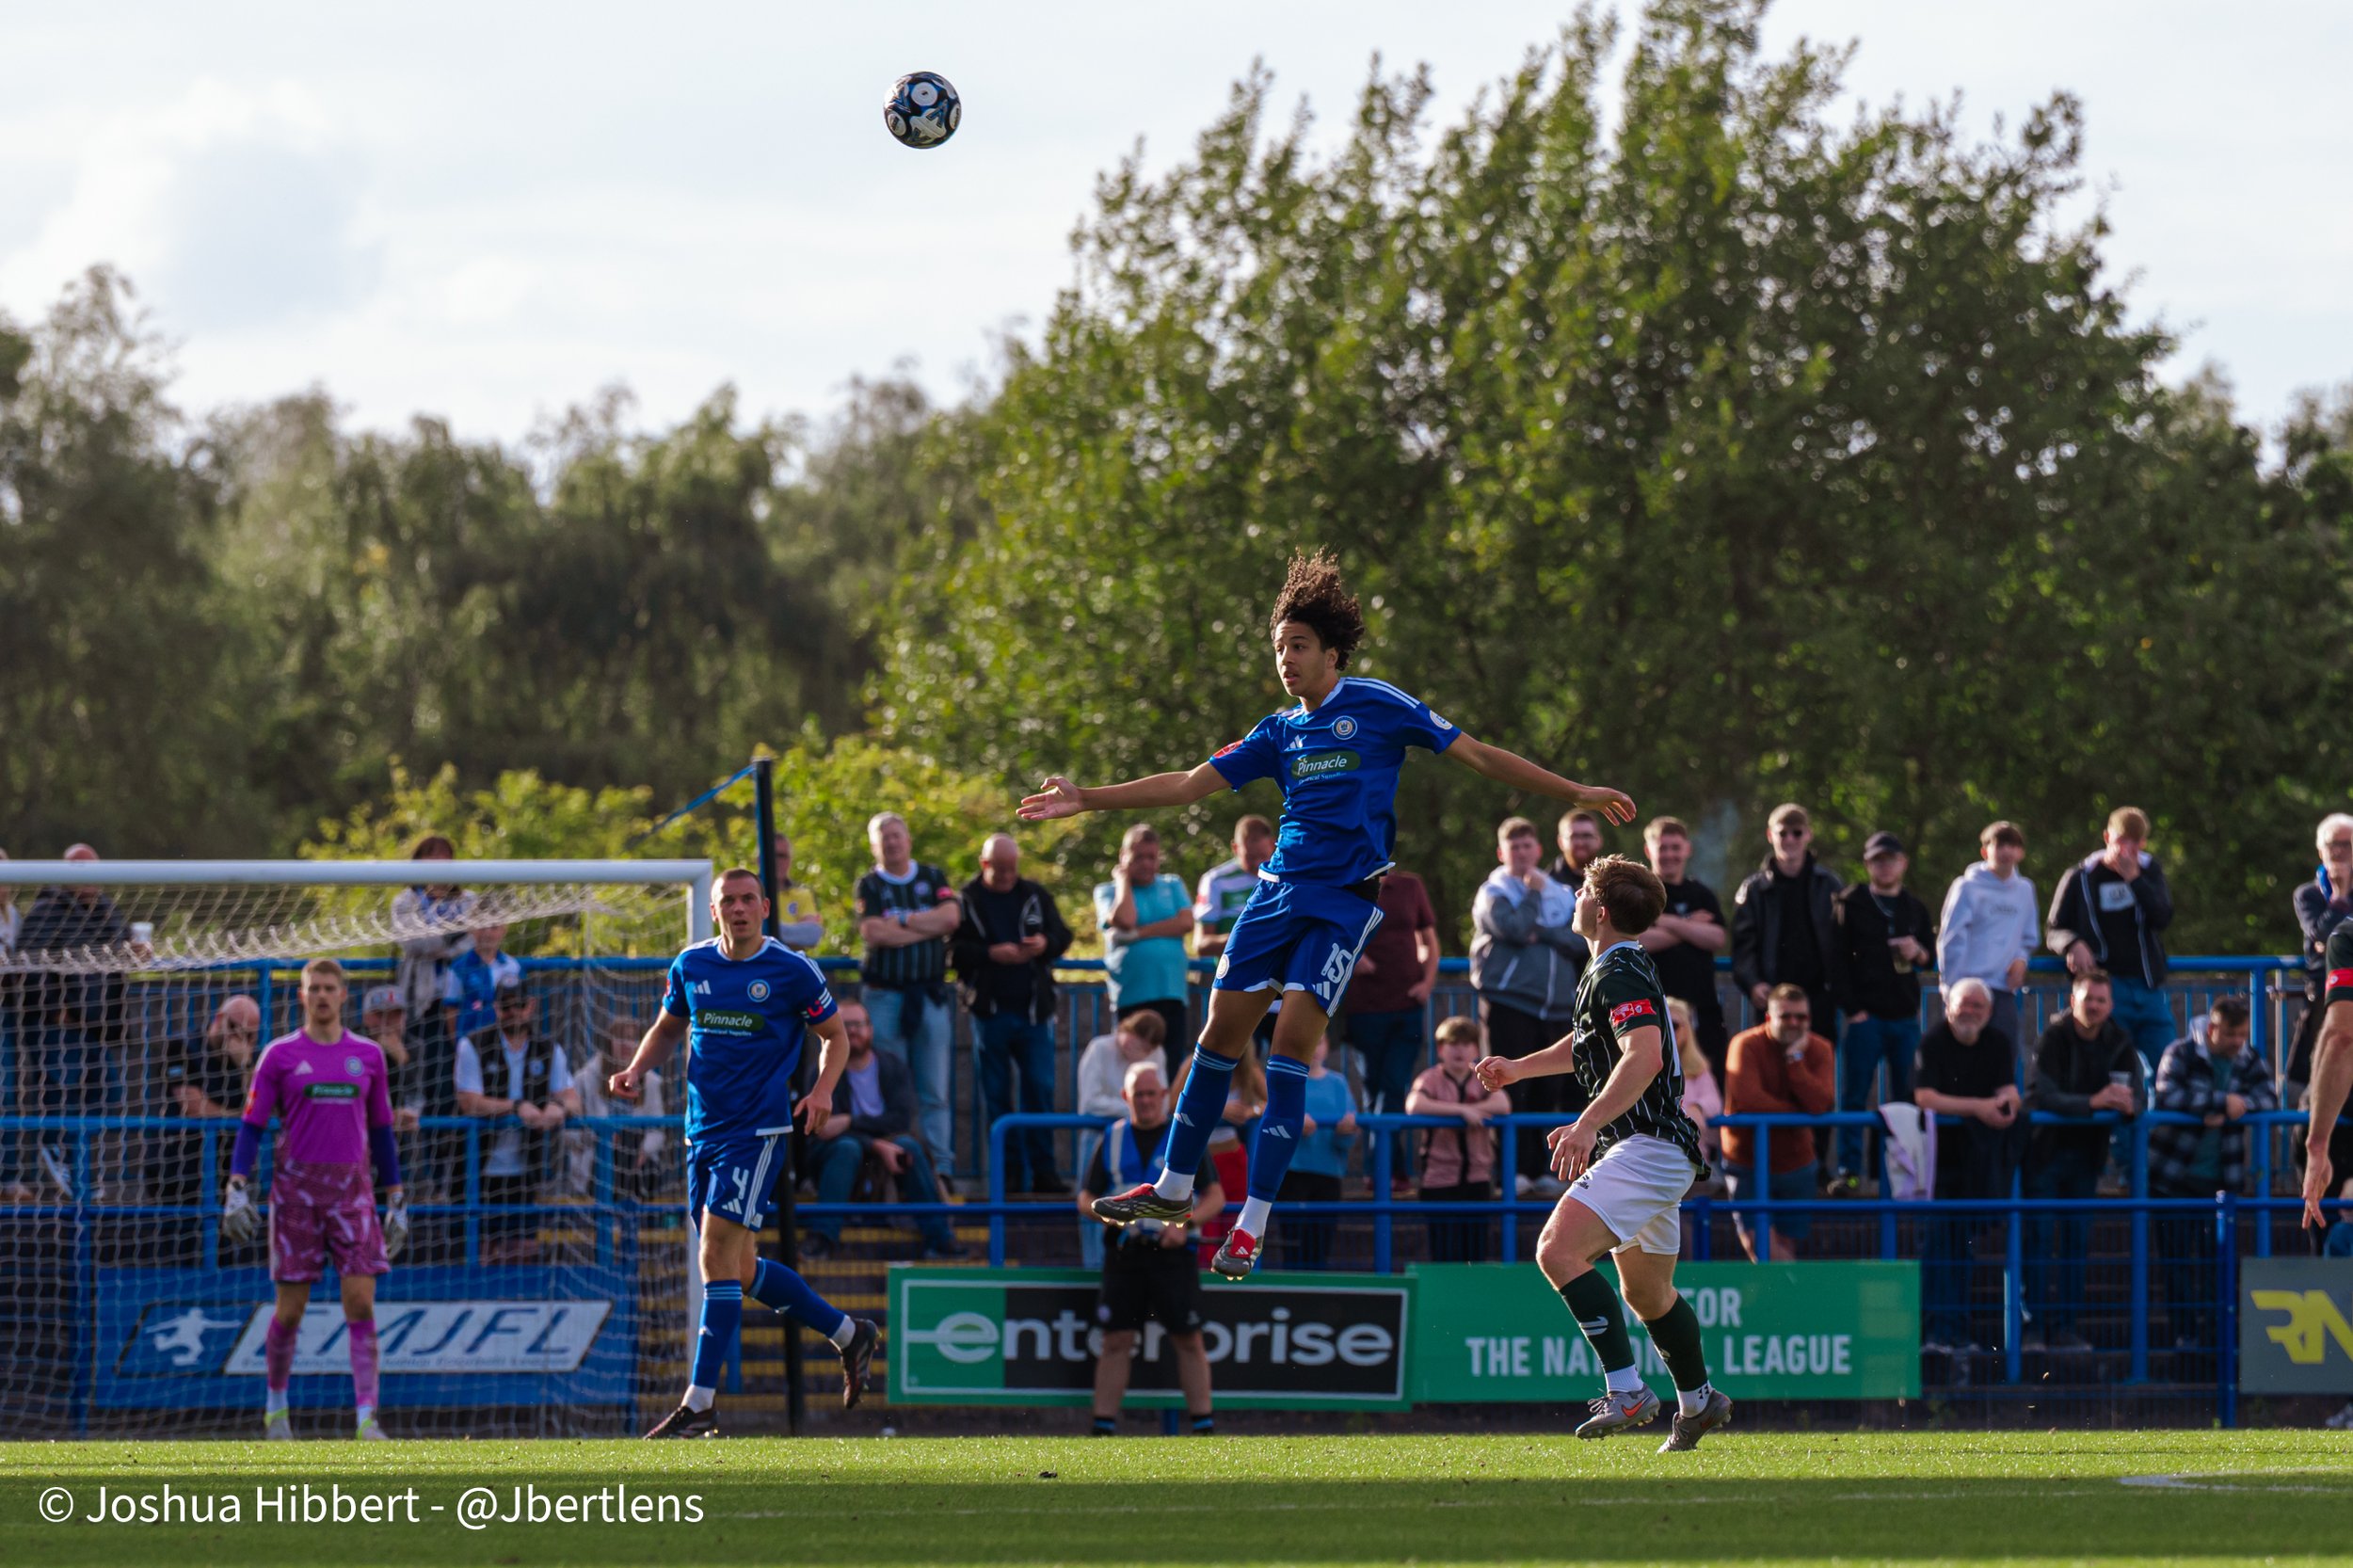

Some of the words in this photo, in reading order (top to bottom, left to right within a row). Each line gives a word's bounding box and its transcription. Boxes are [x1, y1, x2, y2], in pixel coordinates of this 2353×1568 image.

[1297, 755, 1348, 775] Pinnacle
[1321, 942, 1353, 984] 15
[703, 1012, 753, 1028] Pinnacle
[1465, 1336, 1532, 1377] THE
[1544, 1336, 1713, 1377] NAON
[1723, 1334, 1852, 1375] LEAGUE
